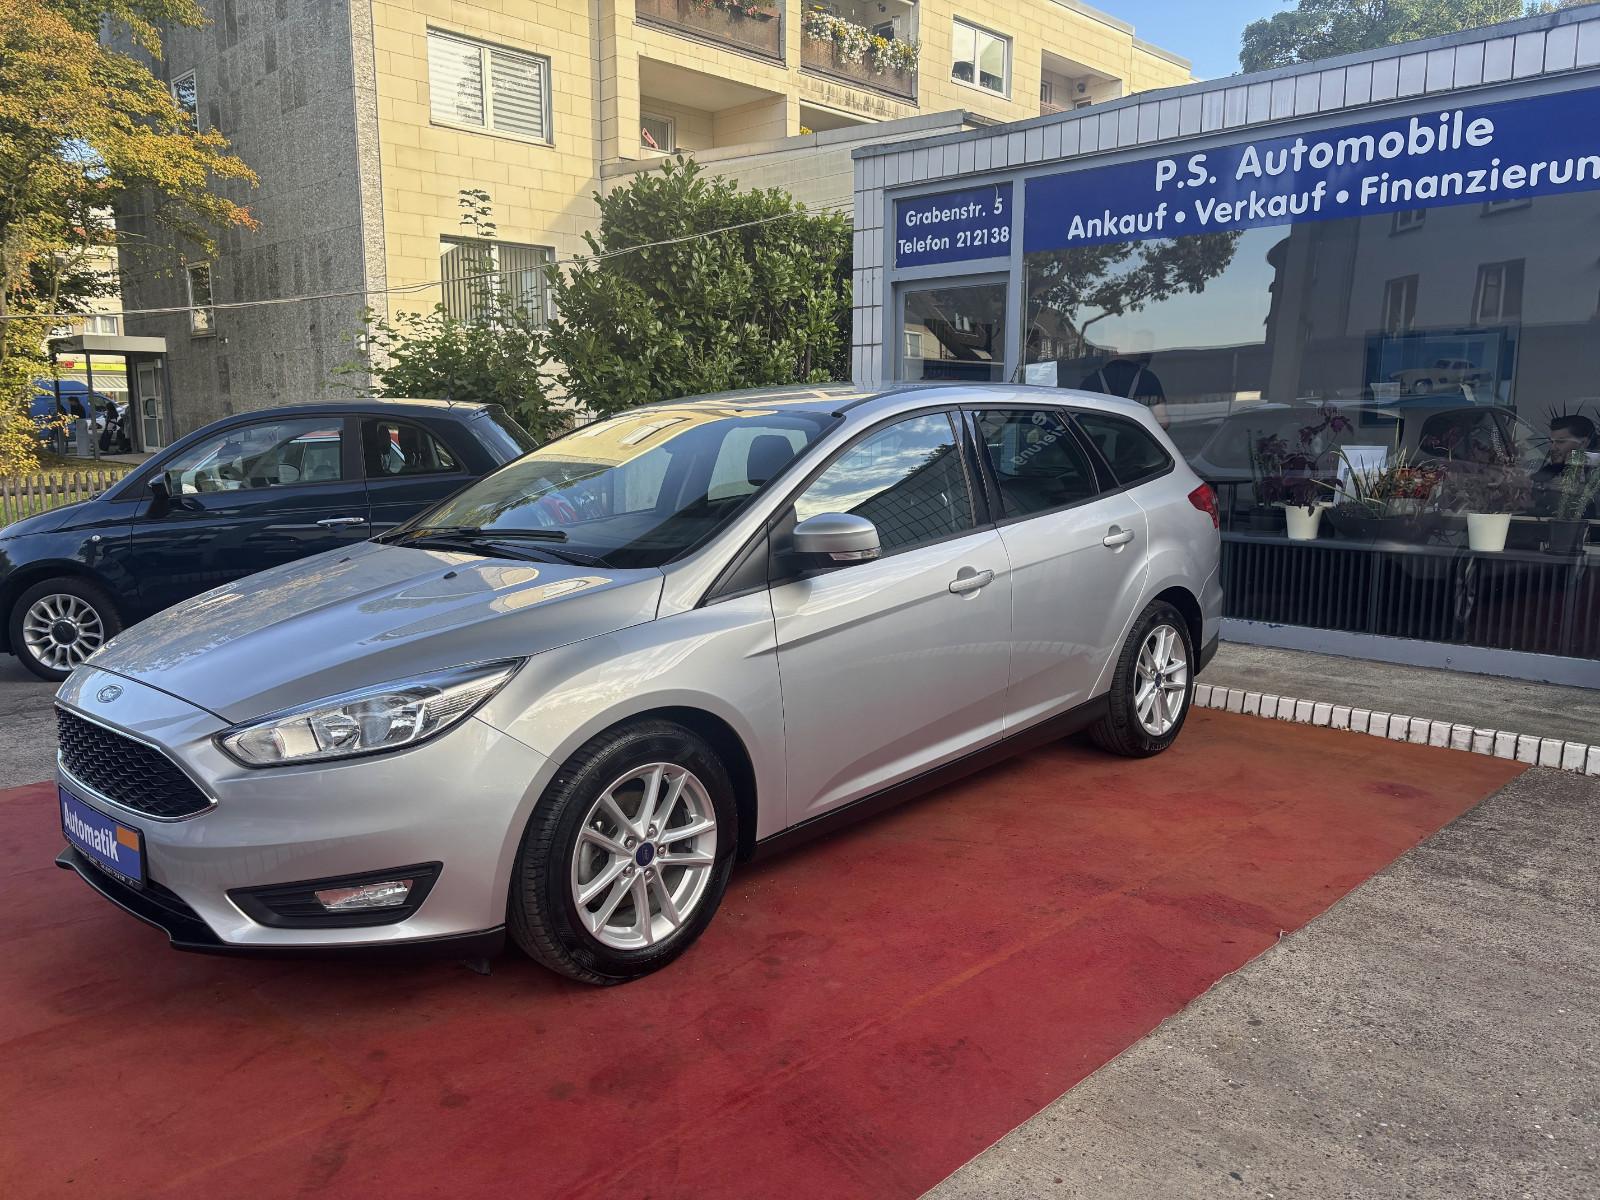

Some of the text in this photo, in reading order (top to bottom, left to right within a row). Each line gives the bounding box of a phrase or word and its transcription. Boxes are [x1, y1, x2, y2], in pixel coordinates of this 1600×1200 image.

[1155, 109, 1495, 192] P.S. Automobile
[905, 197, 1003, 227] Grabenstr. 5
[1067, 154, 1600, 241] Ankauf Verkauf Finanzierun
[898, 234, 950, 255] Telefon
[64, 801, 120, 863] Automatik
